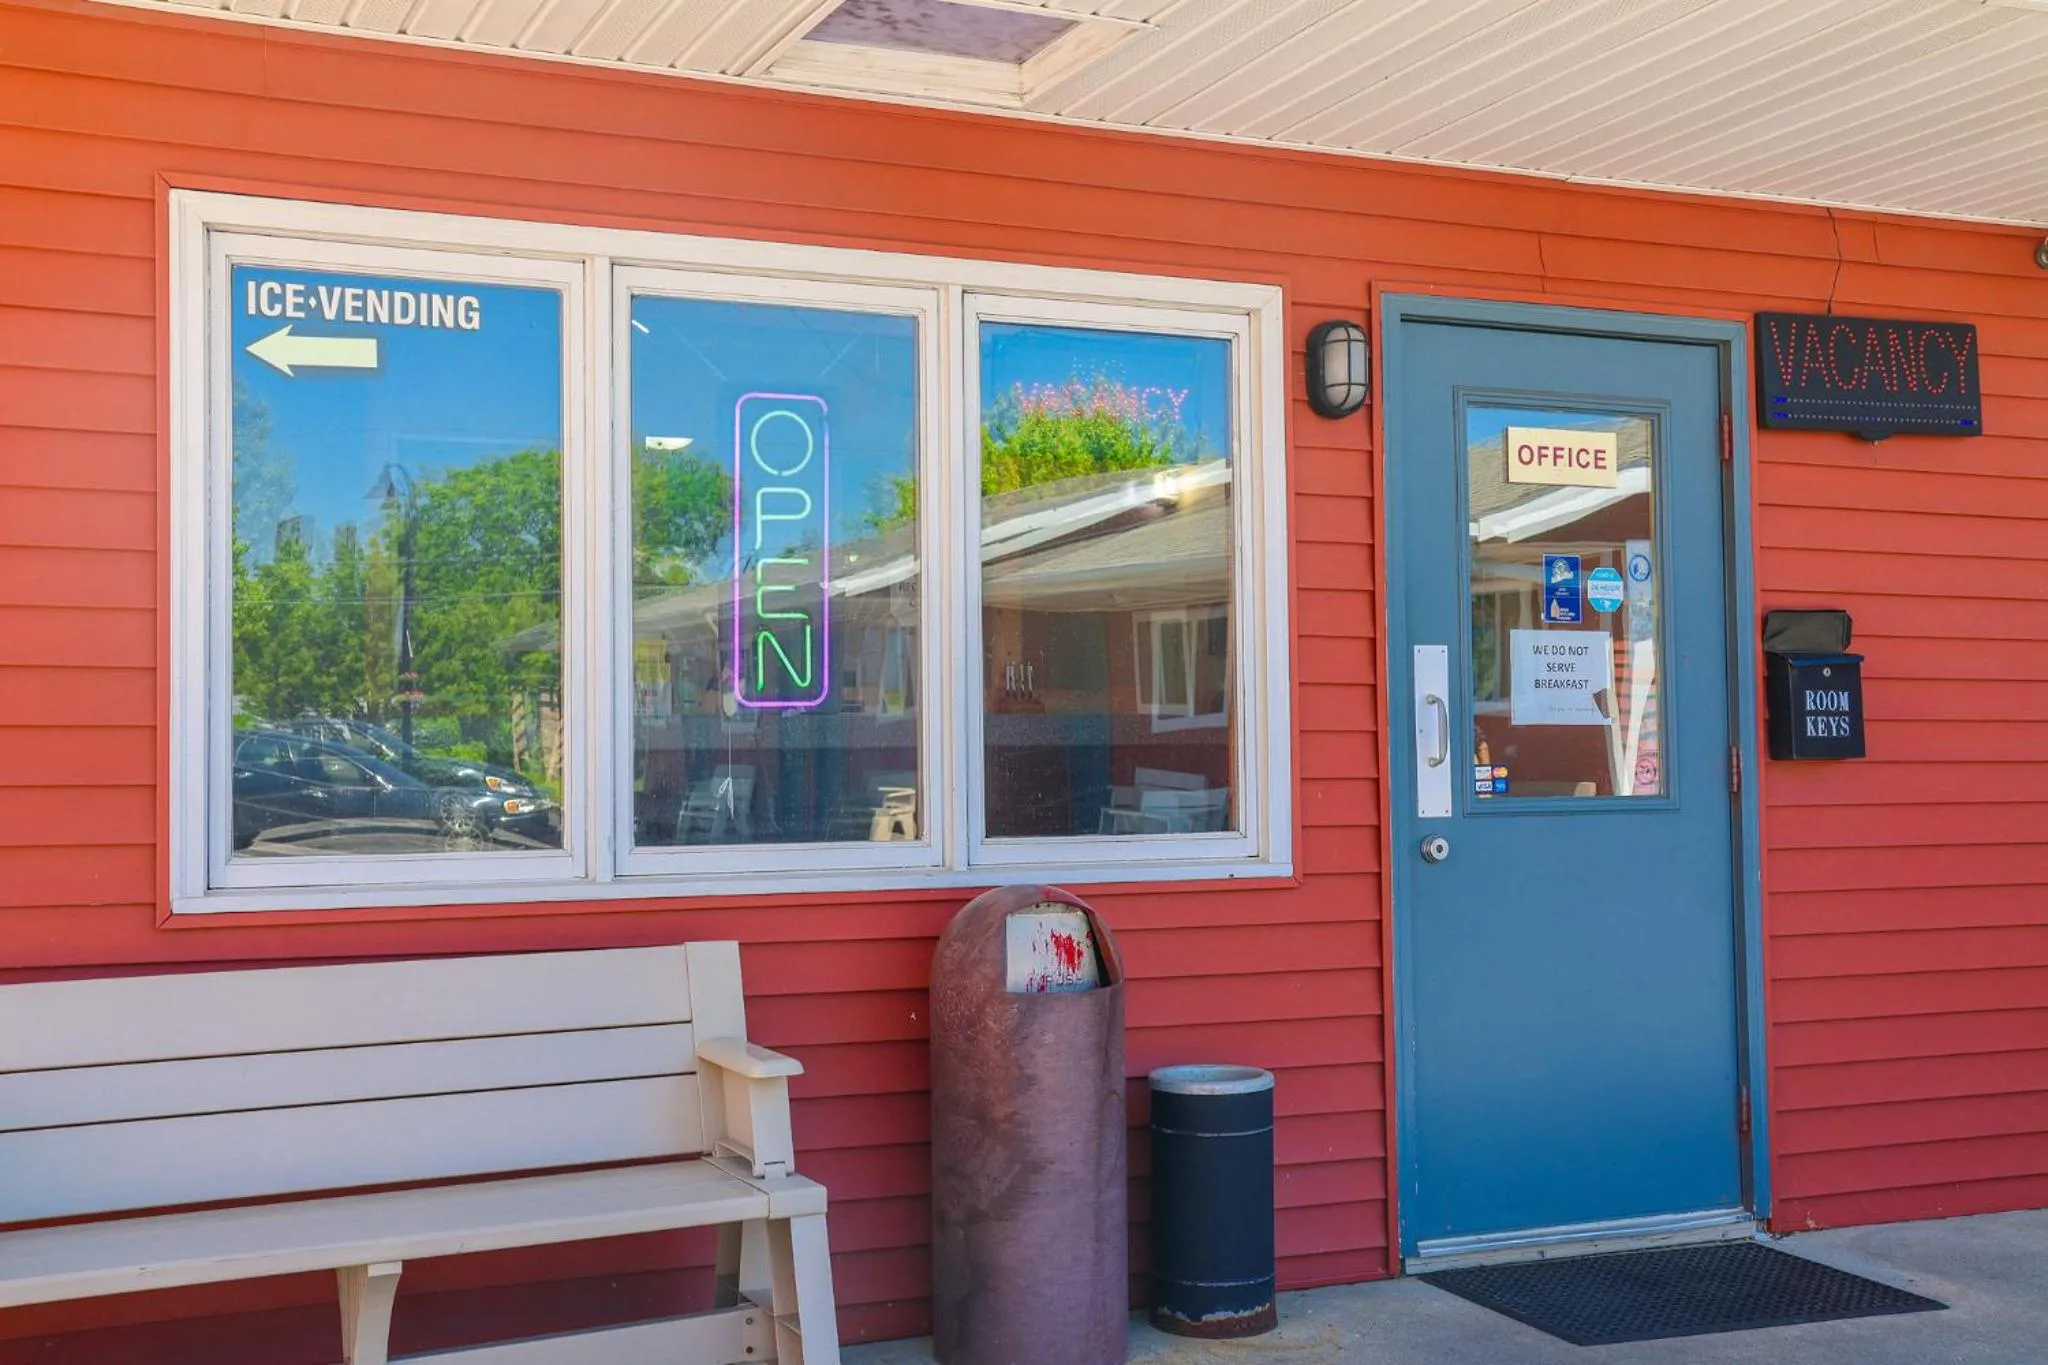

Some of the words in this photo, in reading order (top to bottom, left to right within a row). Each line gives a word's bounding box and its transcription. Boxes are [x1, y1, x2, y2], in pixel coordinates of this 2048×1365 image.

[1770, 320, 1973, 394] VACANCY
[1015, 381, 1189, 421] VACANCY
[1517, 444, 1607, 469] OFFICE
[750, 410, 813, 690] OPEN
[1532, 645, 1549, 655] WE
[1551, 645, 1566, 656] DO
[1568, 646, 1589, 656] NOT
[1546, 662, 1576, 672] SERVE
[1534, 679, 1589, 689] BREAKFAST
[1805, 690, 1849, 711] ROOM
[1806, 716, 1850, 737] KEYS
